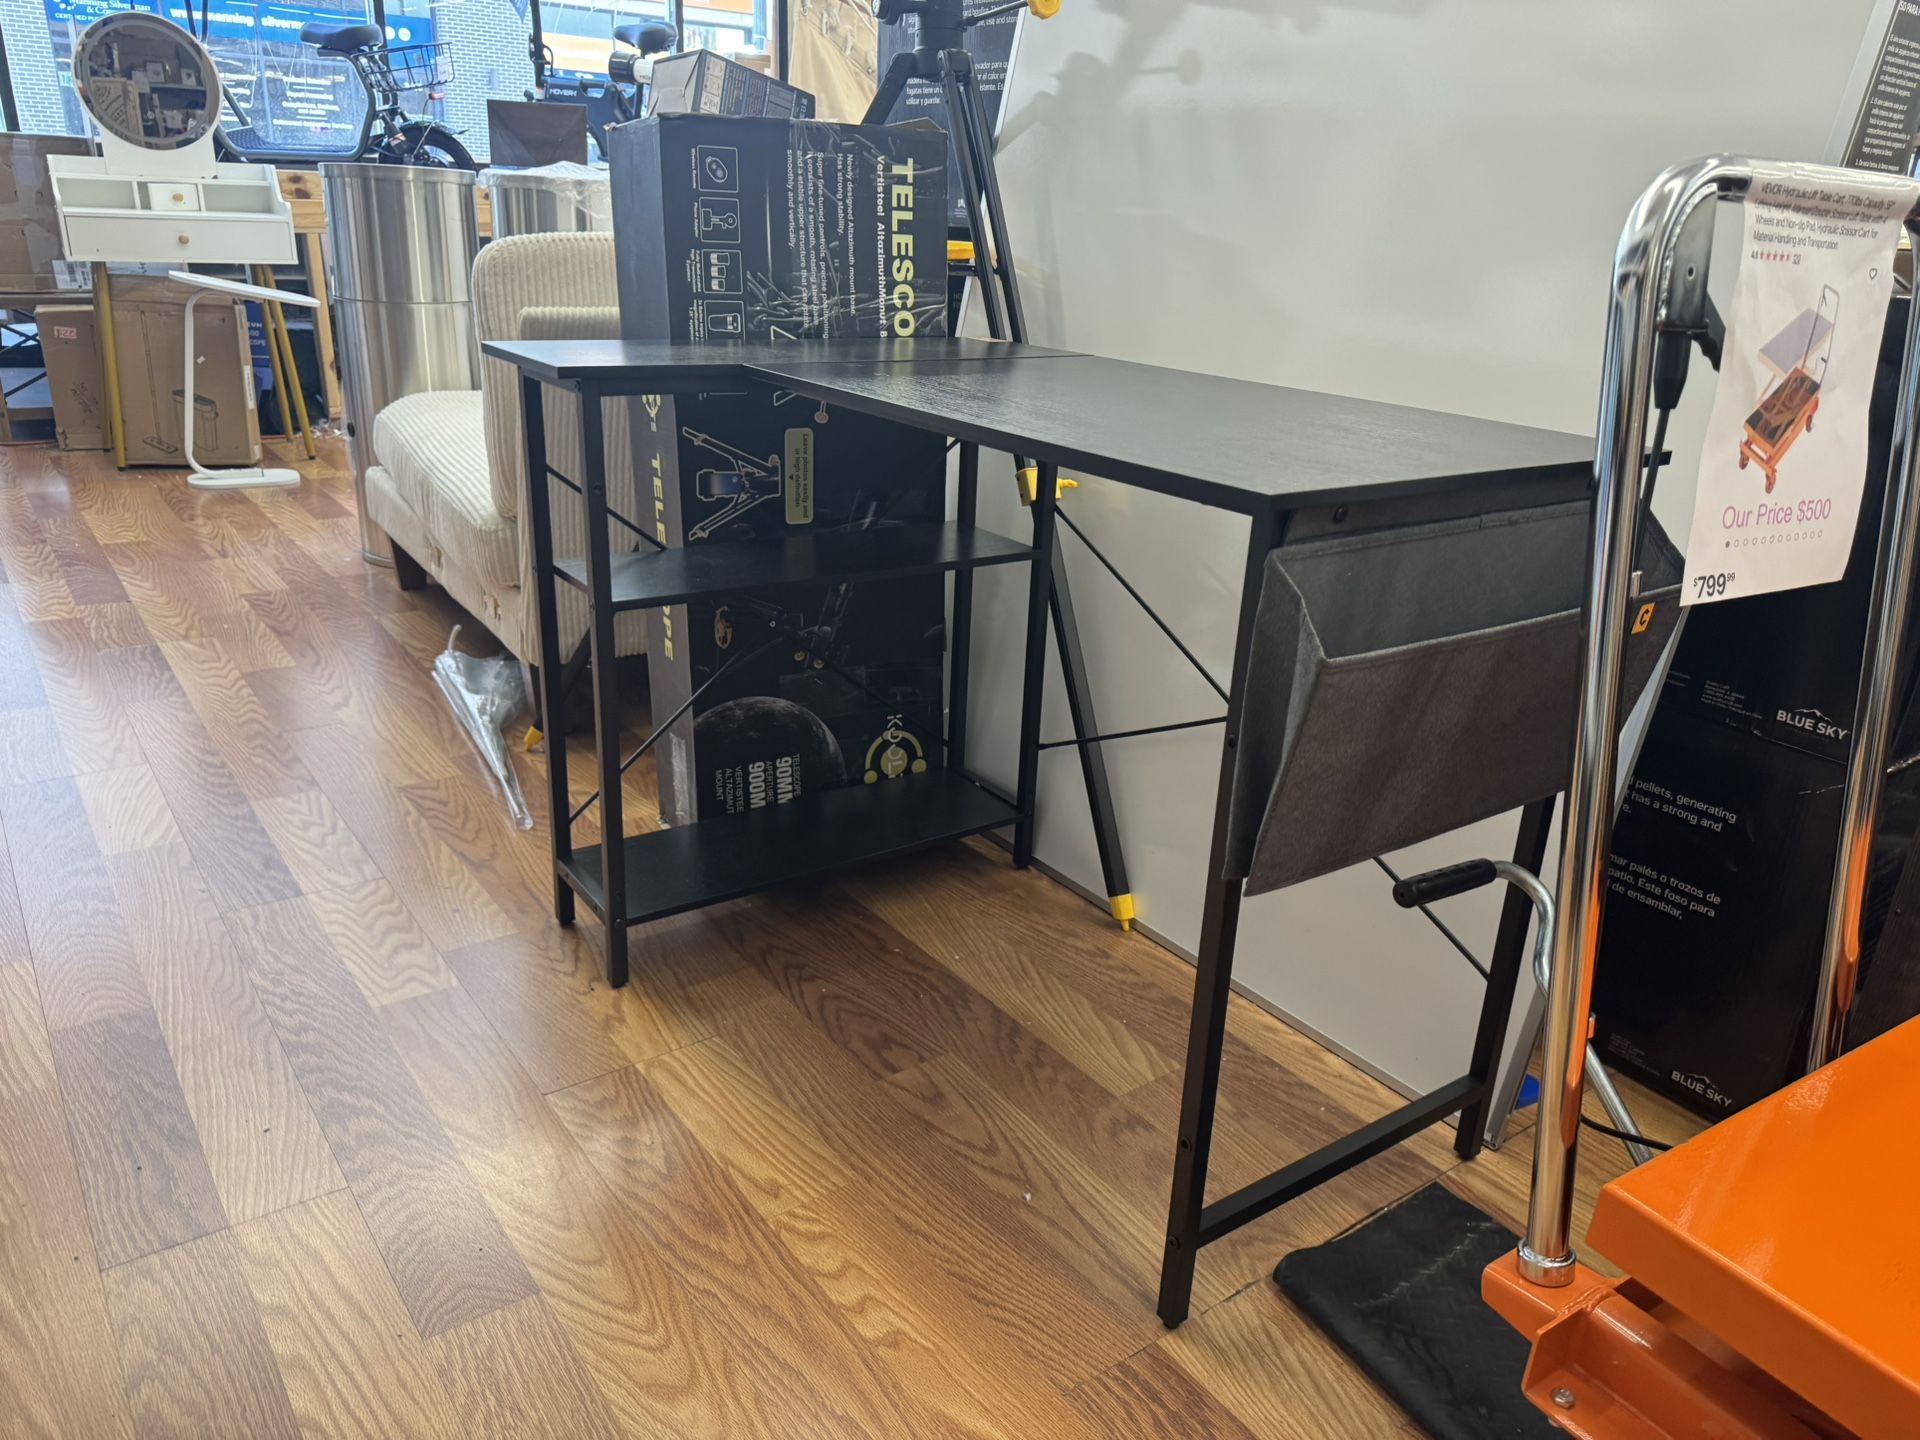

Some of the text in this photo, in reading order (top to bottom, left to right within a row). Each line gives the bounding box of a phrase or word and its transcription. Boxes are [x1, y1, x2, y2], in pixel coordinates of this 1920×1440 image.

[787, 150, 795, 189] smoothly
[816, 152, 824, 177] Super
[797, 204, 805, 228] upper
[808, 196, 815, 205] of
[846, 182, 854, 219] designed
[788, 209, 796, 249] vertically.
[1722, 498, 1832, 529] Our Price $500
[1776, 709, 1848, 740] BLUE SKY
[715, 769, 724, 800] MOUNT
[766, 761, 774, 802] APERTURE
[793, 754, 801, 797] TELESCOPE
[1631, 790, 1723, 832] has a strong and
[1635, 779, 1737, 824] pellets, generating
[1612, 882, 1683, 920] de ensamblar,
[1629, 861, 1658, 879] palés
[1660, 875, 1667, 883] o
[1669, 877, 1704, 899] trozos
[1706, 892, 1721, 905] de
[1637, 878, 1662, 896] Este
[1664, 888, 1689, 906] foso
[1689, 901, 1716, 918] para
[1671, 1070, 1733, 1107] BLUE SKY
